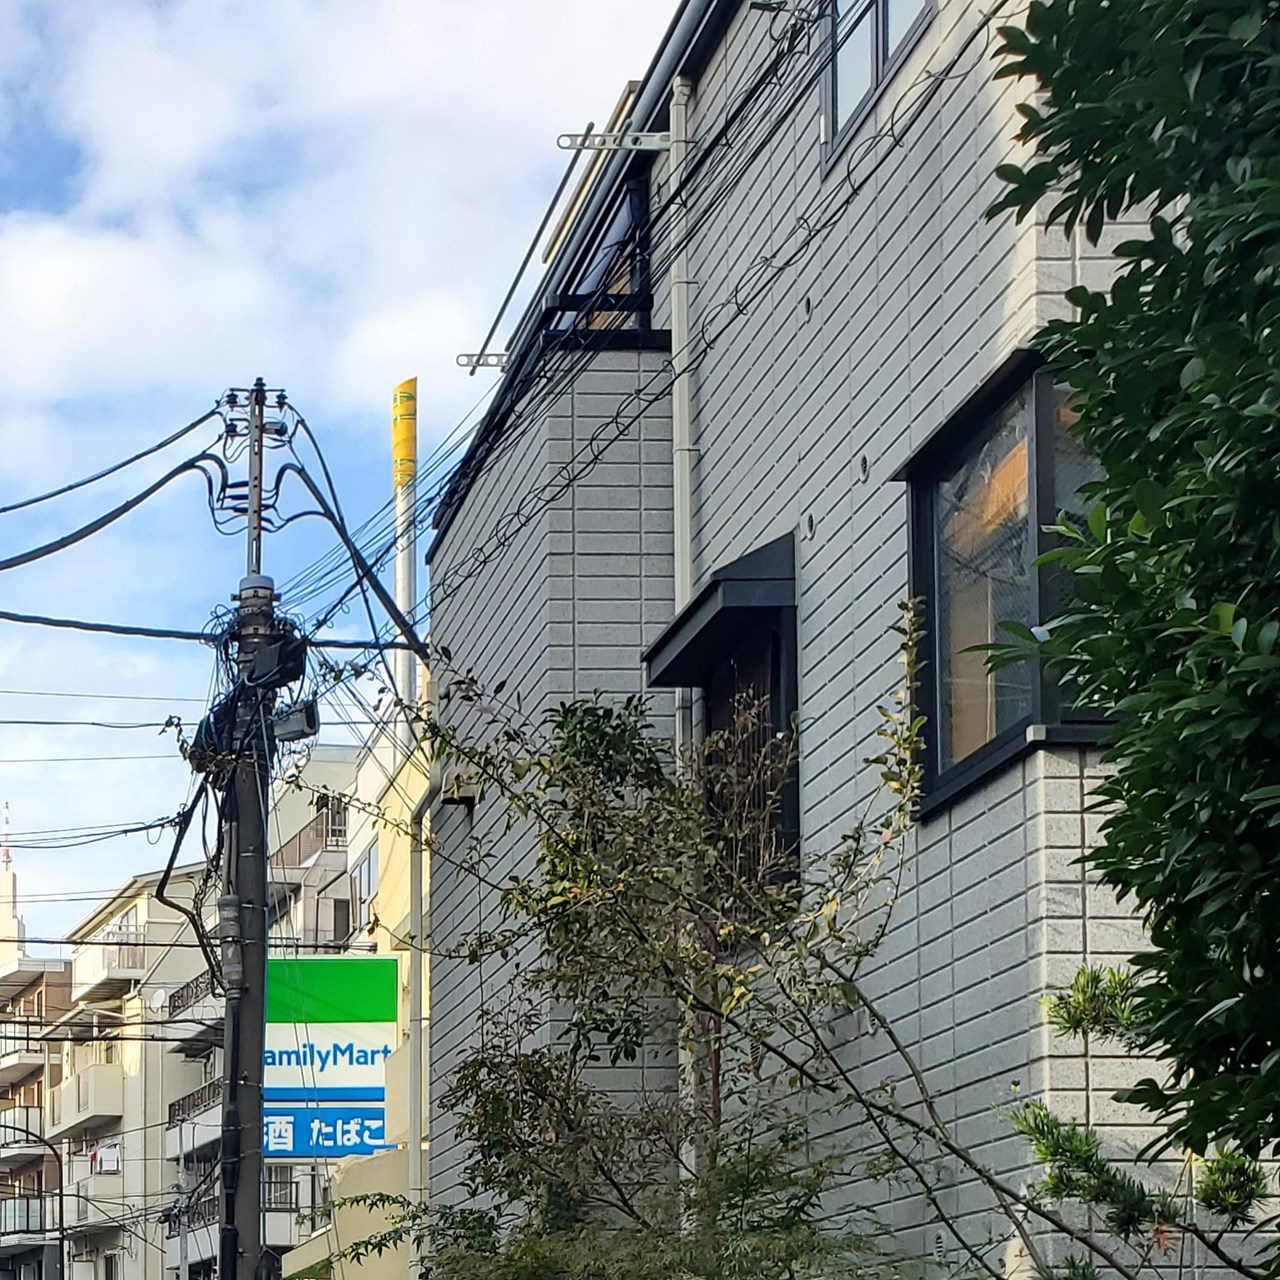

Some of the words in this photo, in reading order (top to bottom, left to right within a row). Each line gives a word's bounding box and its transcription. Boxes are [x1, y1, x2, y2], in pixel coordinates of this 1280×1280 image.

[263, 1043, 392, 1073] amilyMart
[310, 1117, 385, 1147] たばこ
